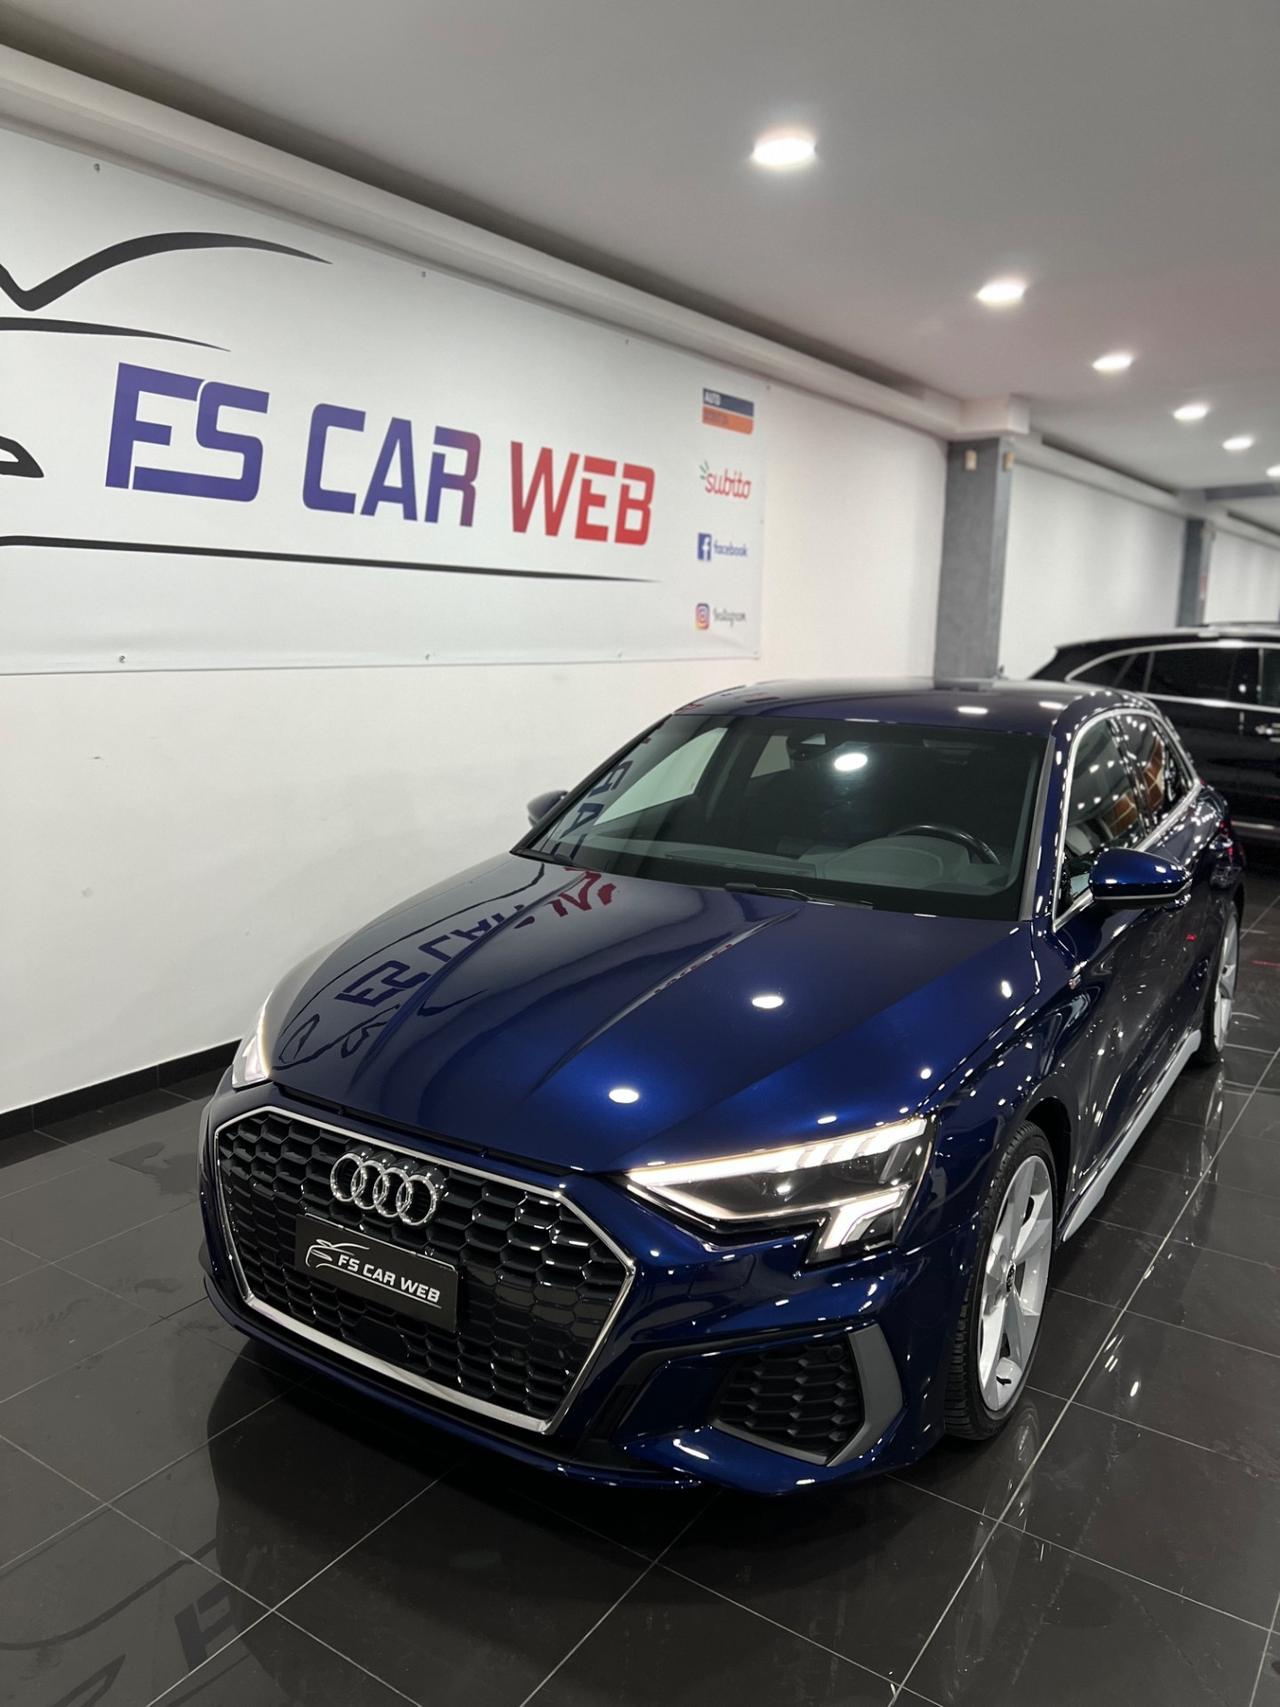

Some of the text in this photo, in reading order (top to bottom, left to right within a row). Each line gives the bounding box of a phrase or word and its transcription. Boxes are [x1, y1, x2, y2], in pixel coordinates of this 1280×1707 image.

[302, 403, 481, 528] CAR
[509, 441, 656, 546] WEB
[705, 468, 752, 500] subito
[713, 539, 748, 557] facebook
[362, 1263, 396, 1287] CAR
[400, 1276, 441, 1303] WEB
